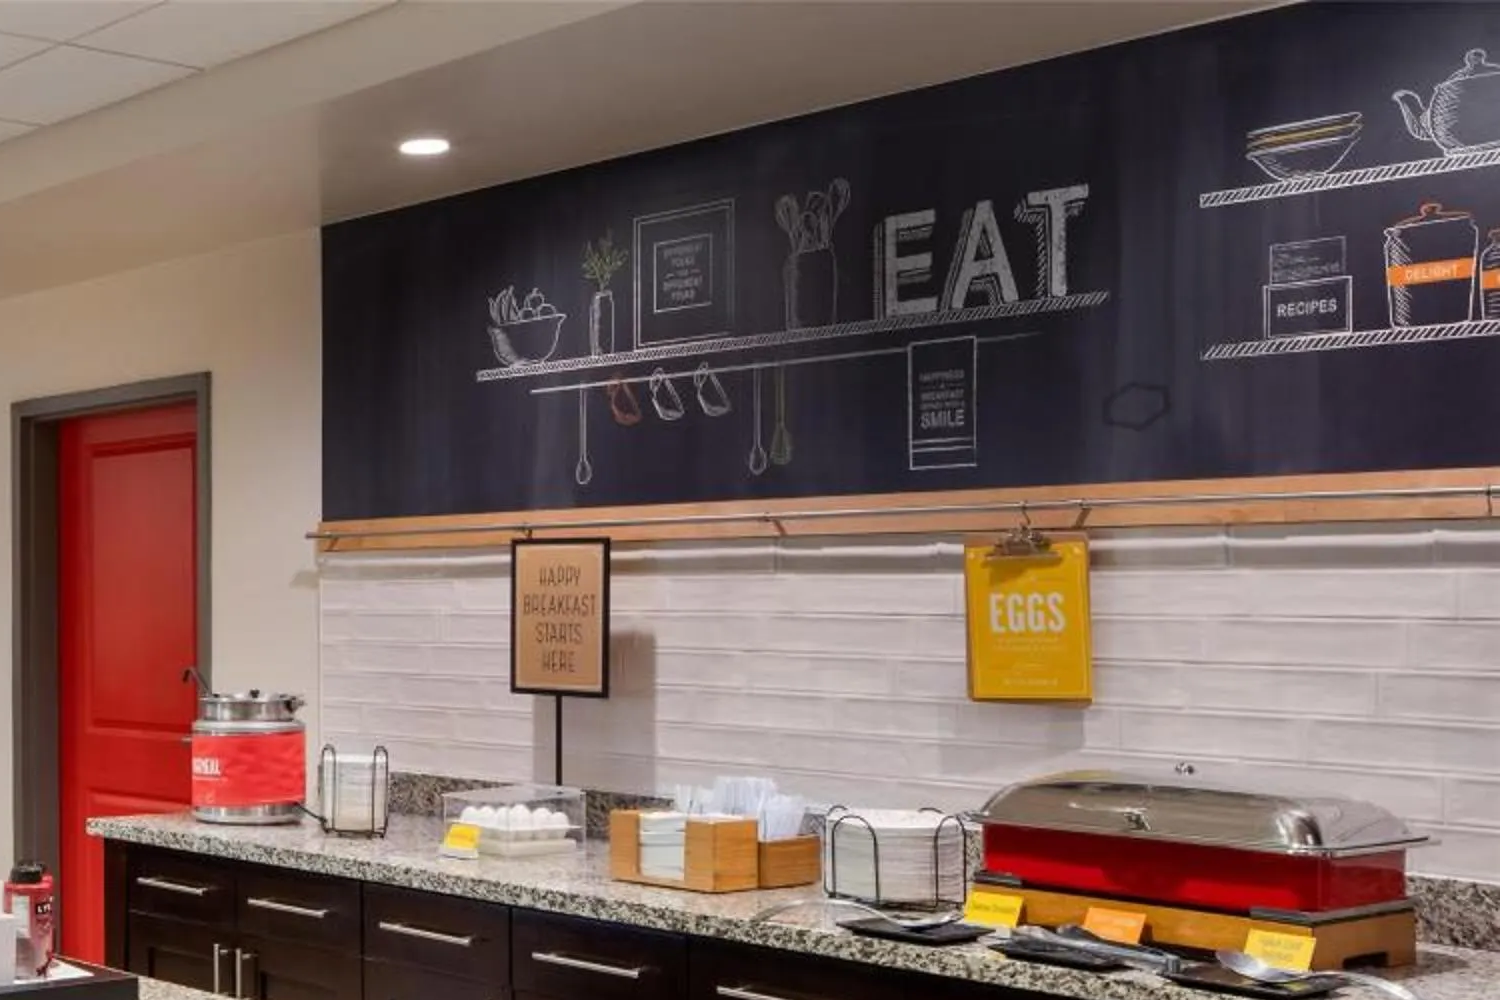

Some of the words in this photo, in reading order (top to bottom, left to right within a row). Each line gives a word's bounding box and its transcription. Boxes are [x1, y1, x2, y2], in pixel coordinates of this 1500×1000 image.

[873, 184, 1089, 320] EAT
[1404, 264, 1458, 281] DELIGHT
[1277, 298, 1337, 317] RECIPES
[920, 409, 965, 430] SMILE
[539, 565, 581, 586] HAPPY
[523, 594, 596, 617] BREAKFAST
[989, 591, 1066, 633] EGGS
[535, 622, 583, 644] STARTS
[543, 650, 576, 673] HERE
